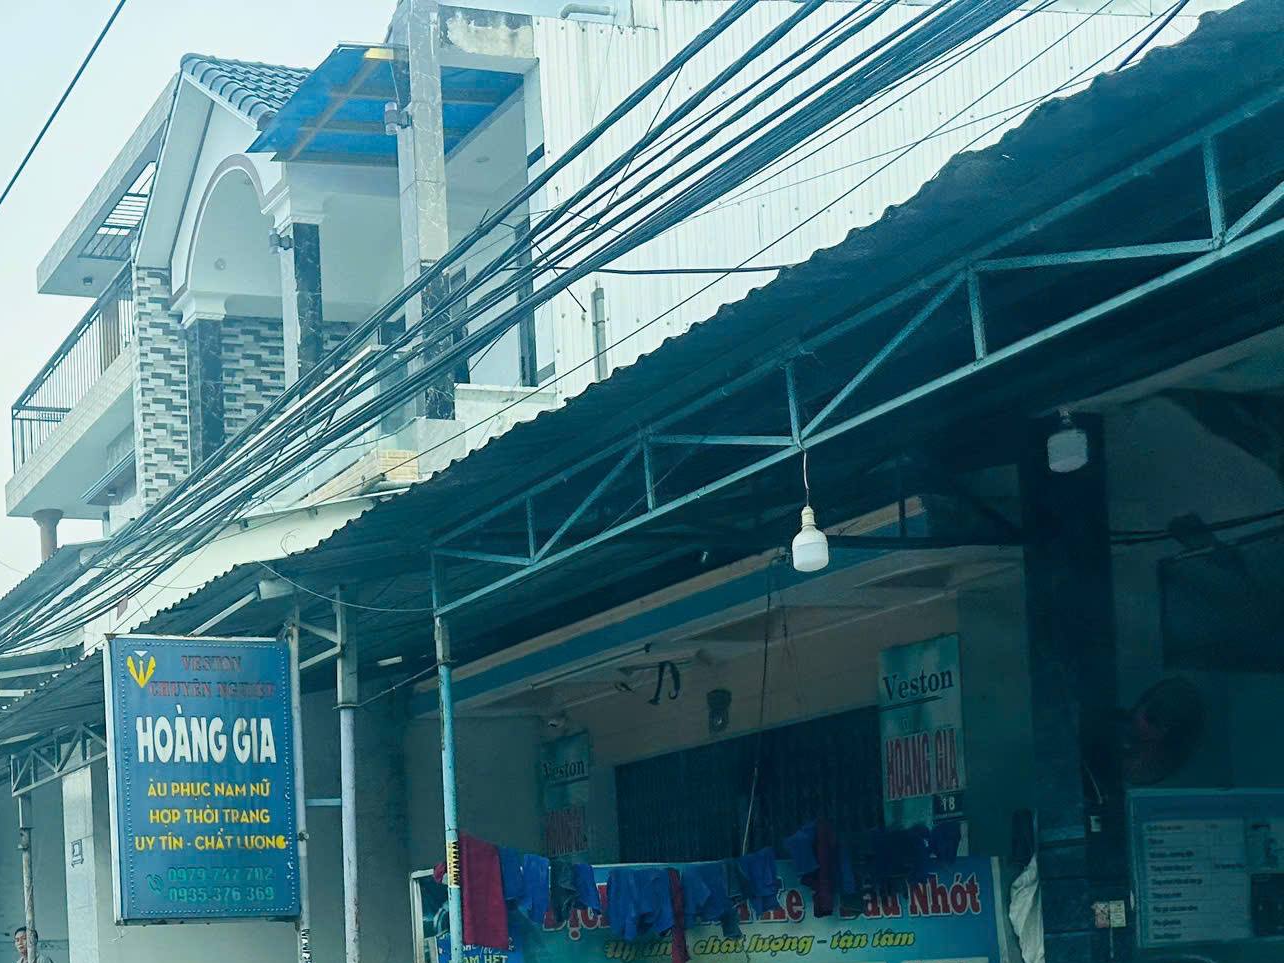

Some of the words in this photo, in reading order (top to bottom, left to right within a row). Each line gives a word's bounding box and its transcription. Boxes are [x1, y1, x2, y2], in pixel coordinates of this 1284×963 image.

[883, 669, 955, 700] Veston
[136, 704, 228, 764] HOÀNG
[232, 717, 278, 764] GIA
[171, 782, 211, 801] PHỤC
[214, 783, 247, 797] NAM
[250, 778, 271, 797] NỮ
[149, 808, 181, 828] HỢP
[184, 804, 219, 824] THỜI
[223, 809, 271, 824] TRANG
[134, 836, 155, 852] UY
[159, 831, 184, 851] TÍN
